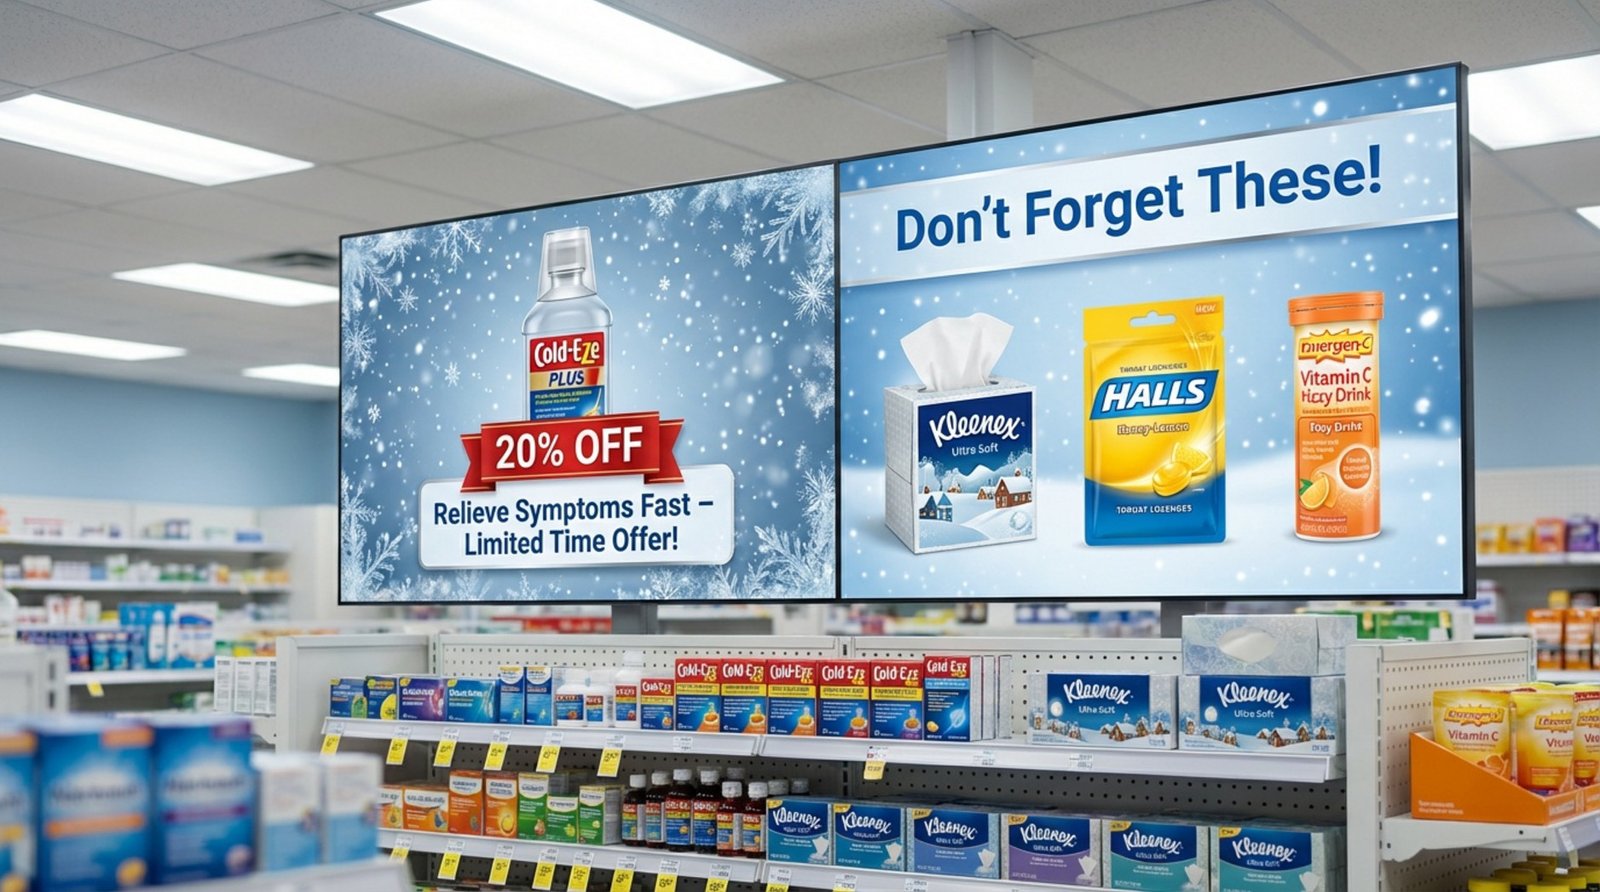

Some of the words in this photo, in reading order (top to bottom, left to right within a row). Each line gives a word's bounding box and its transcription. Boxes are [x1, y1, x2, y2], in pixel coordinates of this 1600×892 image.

[897, 195, 1010, 252] Don’t
[1025, 175, 1184, 238] Forget
[1197, 143, 1382, 214] These!
[534, 338, 600, 368] Cold-Eze
[548, 370, 585, 387] PLUS
[1301, 368, 1360, 386] Vitamin
[1362, 366, 1372, 383] C
[1101, 378, 1206, 413] HALLS
[1335, 386, 1371, 402] Drink
[928, 410, 1021, 448] Kleenex
[495, 431, 564, 470] 20%
[574, 426, 644, 465] OFF
[978, 442, 999, 454] Soft
[433, 500, 509, 525] Relieve
[516, 494, 633, 529] Symptoms
[641, 493, 690, 518] Fast
[465, 530, 543, 556] Limited
[549, 530, 605, 554] Time
[612, 525, 679, 553] Offer!
[1063, 679, 1131, 705] Kleenex
[1217, 681, 1290, 709] Kleenex
[1447, 730, 1489, 741] Vitamin
[1491, 731, 1499, 742] C
